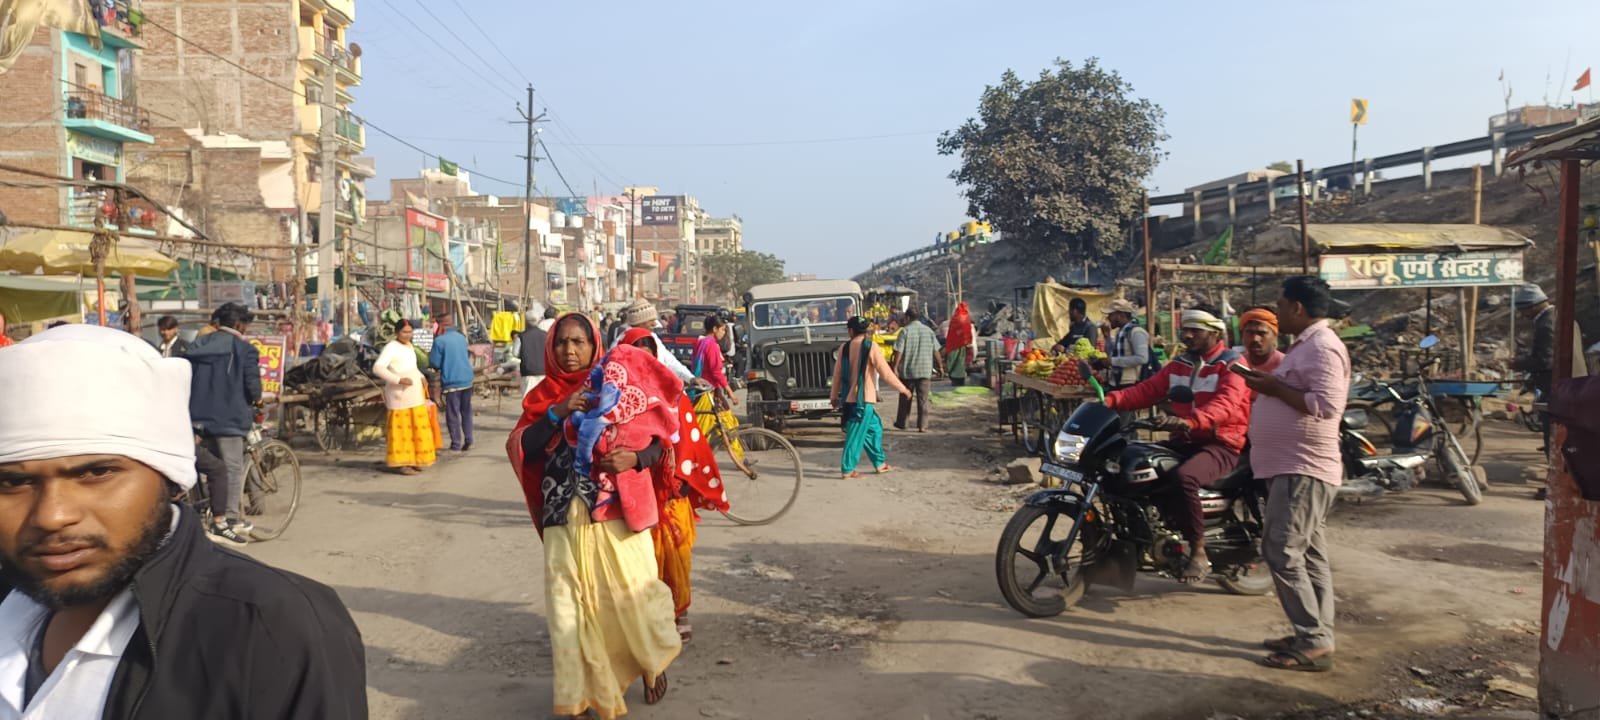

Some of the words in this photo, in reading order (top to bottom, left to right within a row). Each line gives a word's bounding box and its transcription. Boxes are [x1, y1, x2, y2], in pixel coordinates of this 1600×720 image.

[1347, 255, 1401, 286] राजू
[1438, 256, 1491, 279] सेन्टर
[1132, 471, 1152, 481] TVS
